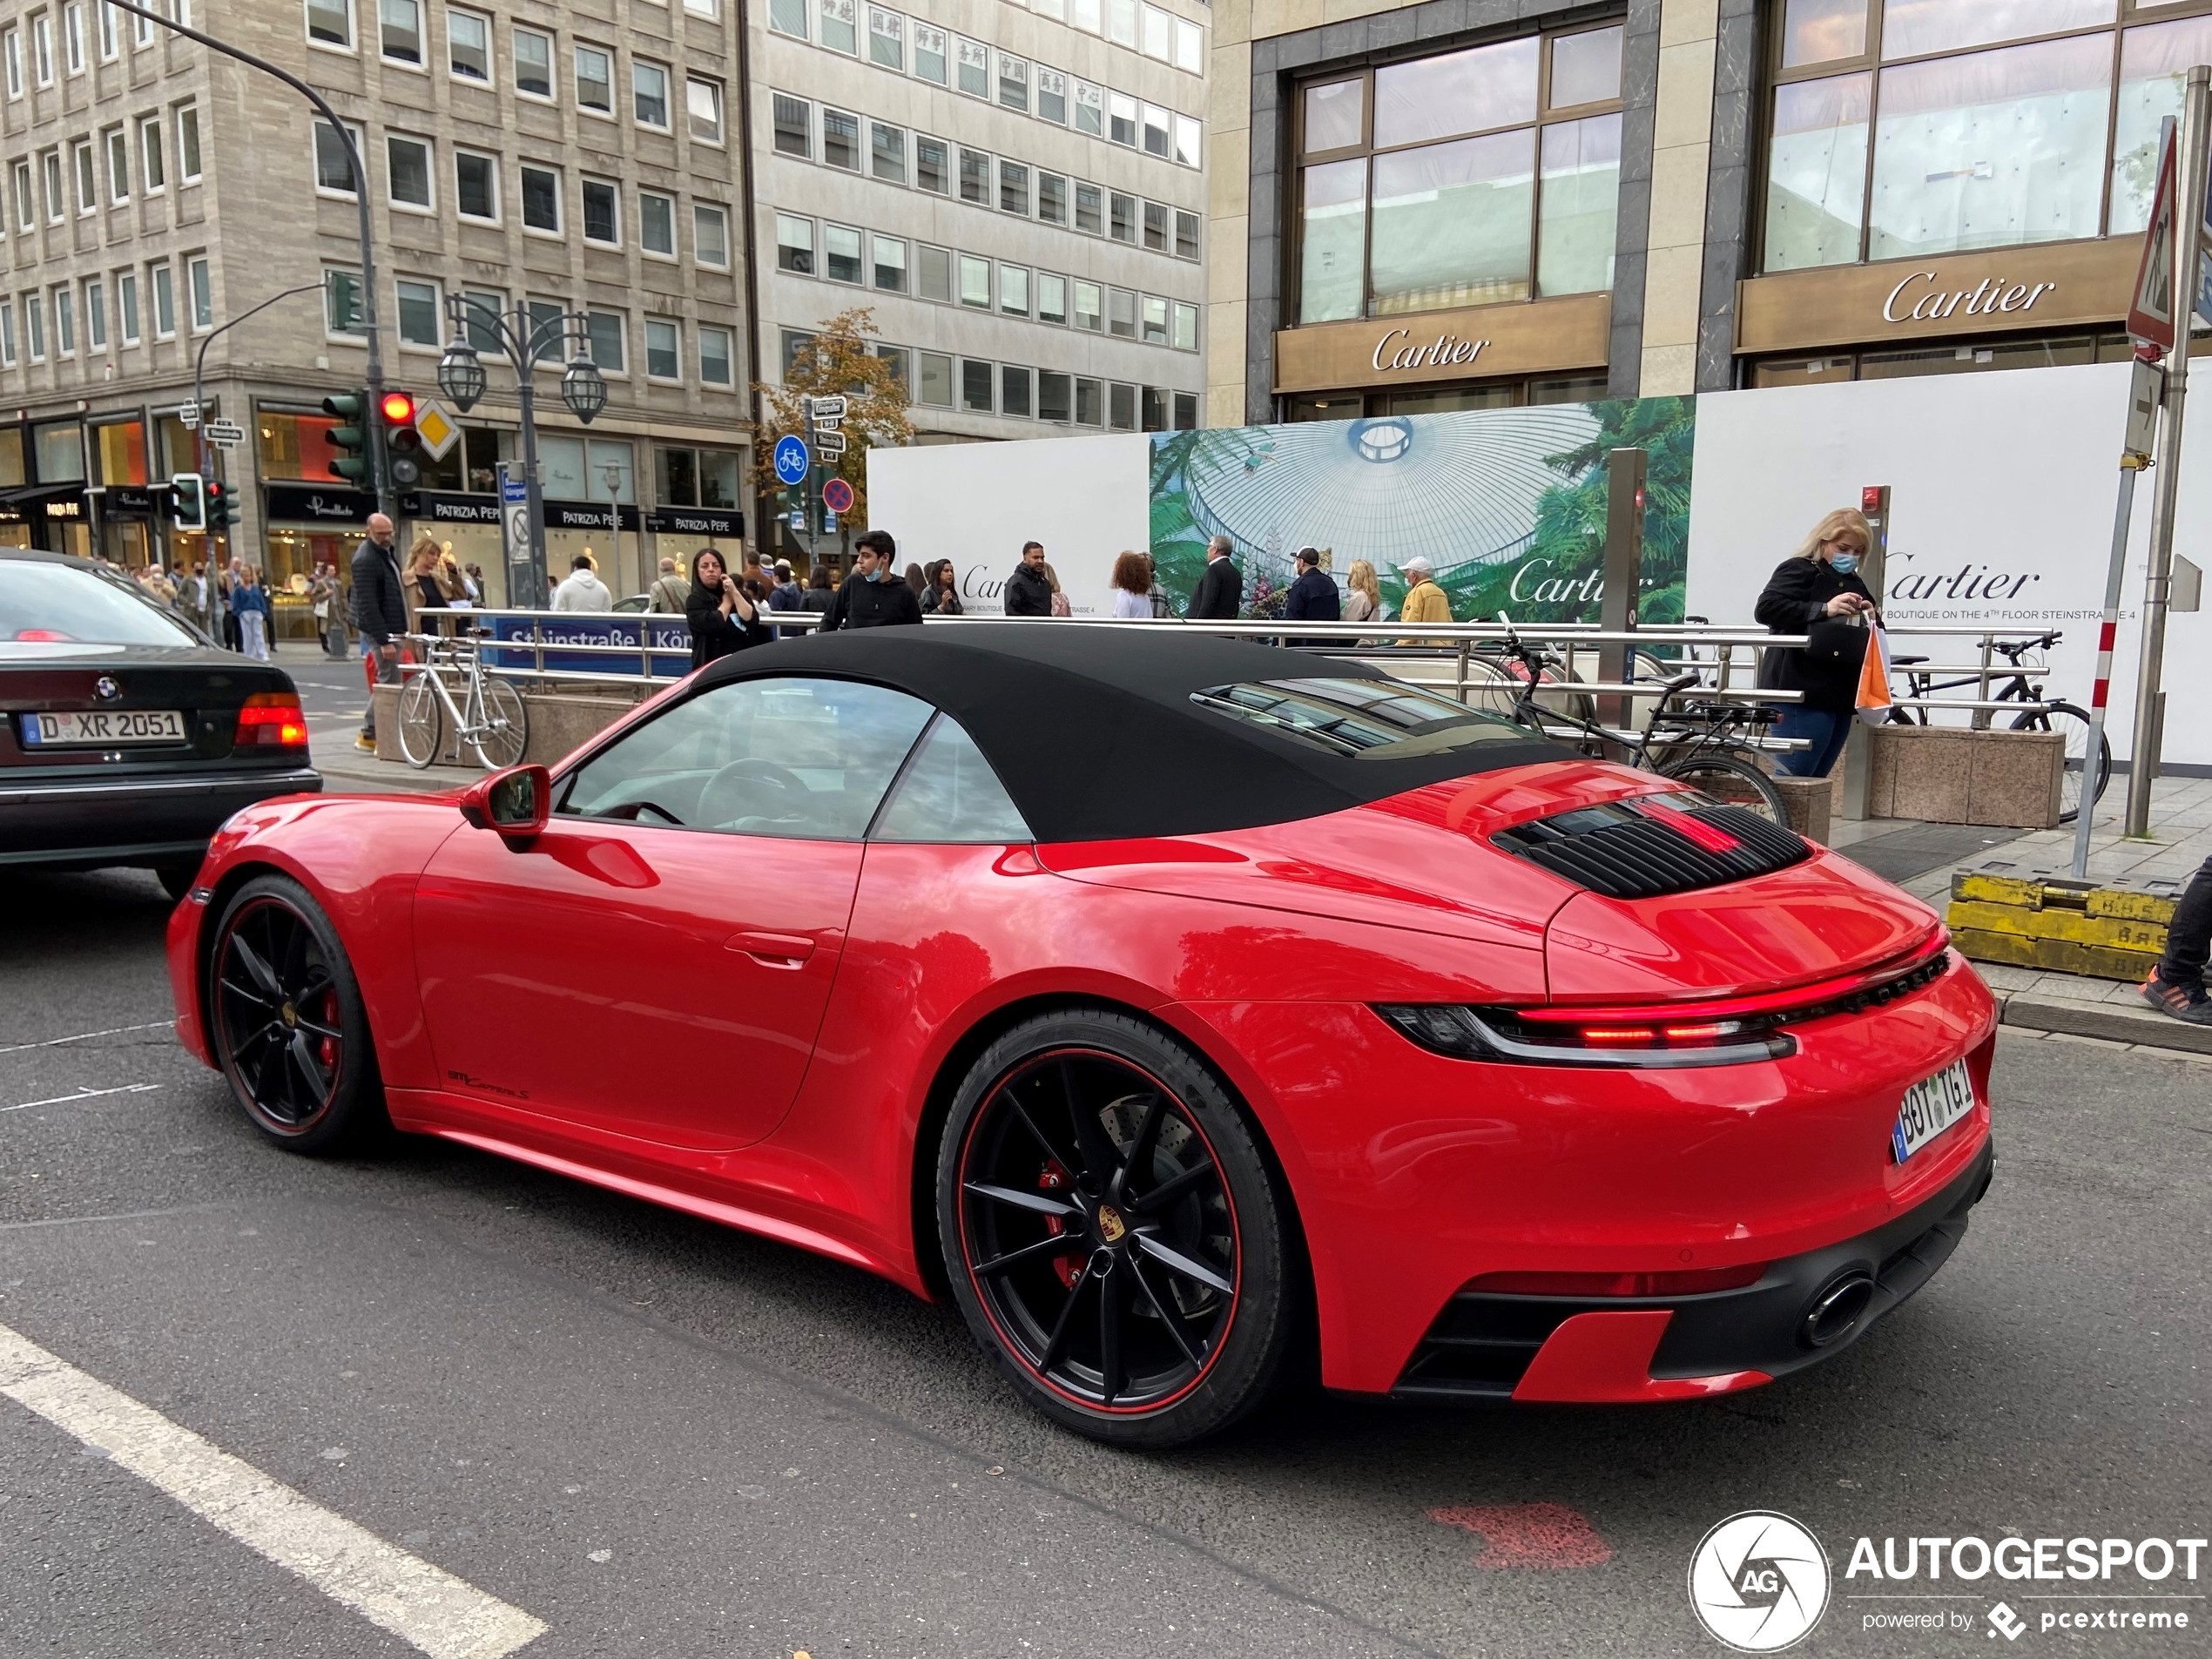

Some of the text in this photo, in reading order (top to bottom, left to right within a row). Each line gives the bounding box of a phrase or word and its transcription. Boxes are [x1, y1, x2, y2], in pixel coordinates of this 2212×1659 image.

[1883, 272, 2055, 322] Cartier
[1372, 328, 1492, 371] Cartier
[435, 503, 478, 519] PATRIZIA
[563, 511, 624, 527] PATRIZIA PEE
[675, 518, 709, 530] PATRIZIA
[711, 520, 730, 532] PEPE
[1885, 551, 2040, 599] artier
[977, 604, 1003, 613] BOUTIQUE
[1886, 610, 1939, 619] BOUTIQUE
[1942, 610, 1958, 619] ON
[1961, 610, 1981, 619] THE
[2002, 610, 2039, 619] FLOOR
[2041, 610, 2127, 619] STEINSTRAE
[2128, 610, 2135, 619] 4
[41, 716, 59, 738] D
[77, 715, 112, 738] XR
[117, 715, 180, 737] 2051
[1899, 1079, 1933, 1145] BOT
